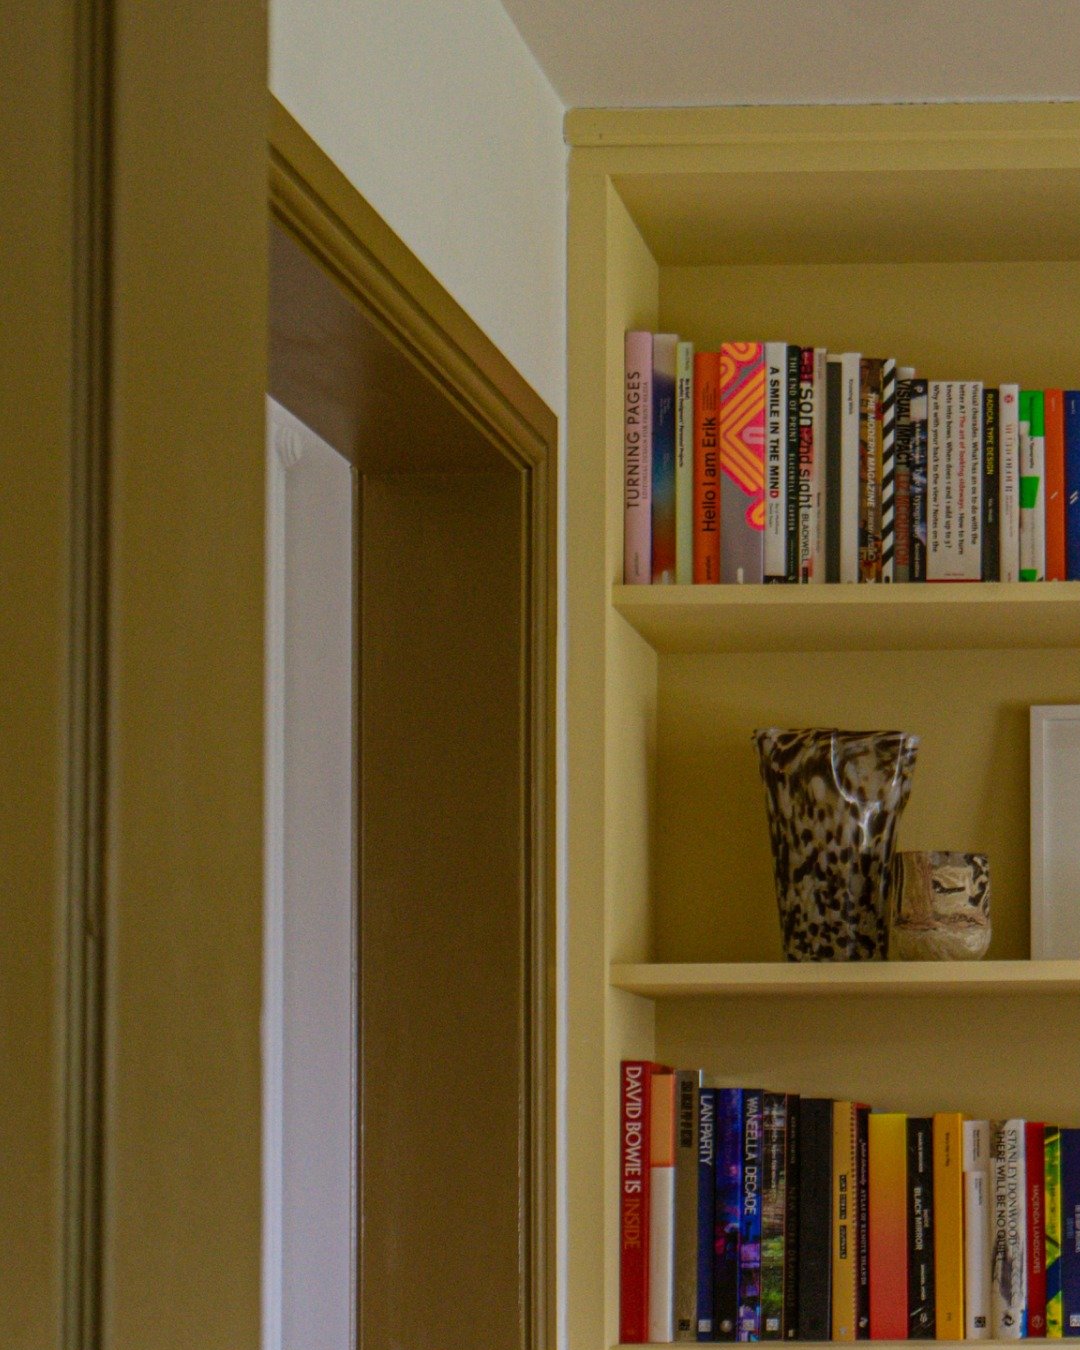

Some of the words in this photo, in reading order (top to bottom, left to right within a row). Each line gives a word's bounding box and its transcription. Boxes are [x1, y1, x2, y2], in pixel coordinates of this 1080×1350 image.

[769, 367, 779, 375] A
[789, 357, 797, 373] THE
[626, 371, 640, 424] PAGES
[769, 379, 779, 418] SMILE
[789, 378, 797, 396] END
[896, 379, 911, 420] VISUAL
[931, 384, 940, 398] Why
[789, 400, 797, 411] OF
[986, 393, 994, 424] RADICAL
[702, 417, 716, 448] Erik
[769, 422, 779, 435] IN
[789, 416, 797, 442] PRINT
[932, 412, 940, 428] with
[769, 438, 779, 462] THE
[896, 424, 911, 466] IMPACT
[931, 428, 940, 446] your
[986, 428, 994, 444] TYPE
[705, 452, 716, 477] am
[932, 448, 940, 462] back
[932, 464, 940, 472] to
[986, 447, 994, 475] DESIGN
[626, 432, 640, 510] TURNING
[769, 465, 779, 499] MIND
[932, 474, 940, 486] the
[799, 469, 813, 509] sight
[701, 490, 716, 532] Hello
[932, 509, 940, 528] Notes
[932, 531, 940, 540] on
[932, 542, 940, 553] the
[625, 1066, 642, 1118] DAVID
[745, 1097, 758, 1160] WANEELLA
[625, 1122, 642, 1176] BOWIE
[996, 1131, 1006, 1163] THERE
[1008, 1129, 1018, 1180] STANLEY
[625, 1180, 642, 1193] IS
[744, 1166, 757, 1215] DECADE
[996, 1166, 1006, 1192] WILL
[914, 1187, 922, 1216] BLACK
[996, 1194, 1006, 1206] BE
[624, 1198, 641, 1249] INSIDE
[996, 1208, 1006, 1228] NO
[1008, 1183, 1018, 1246] DONWOOD
[914, 1218, 923, 1250] MIRROR
[996, 1230, 1006, 1262] QUIET
[1033, 1226, 1041, 1274] LANDSCAPES
